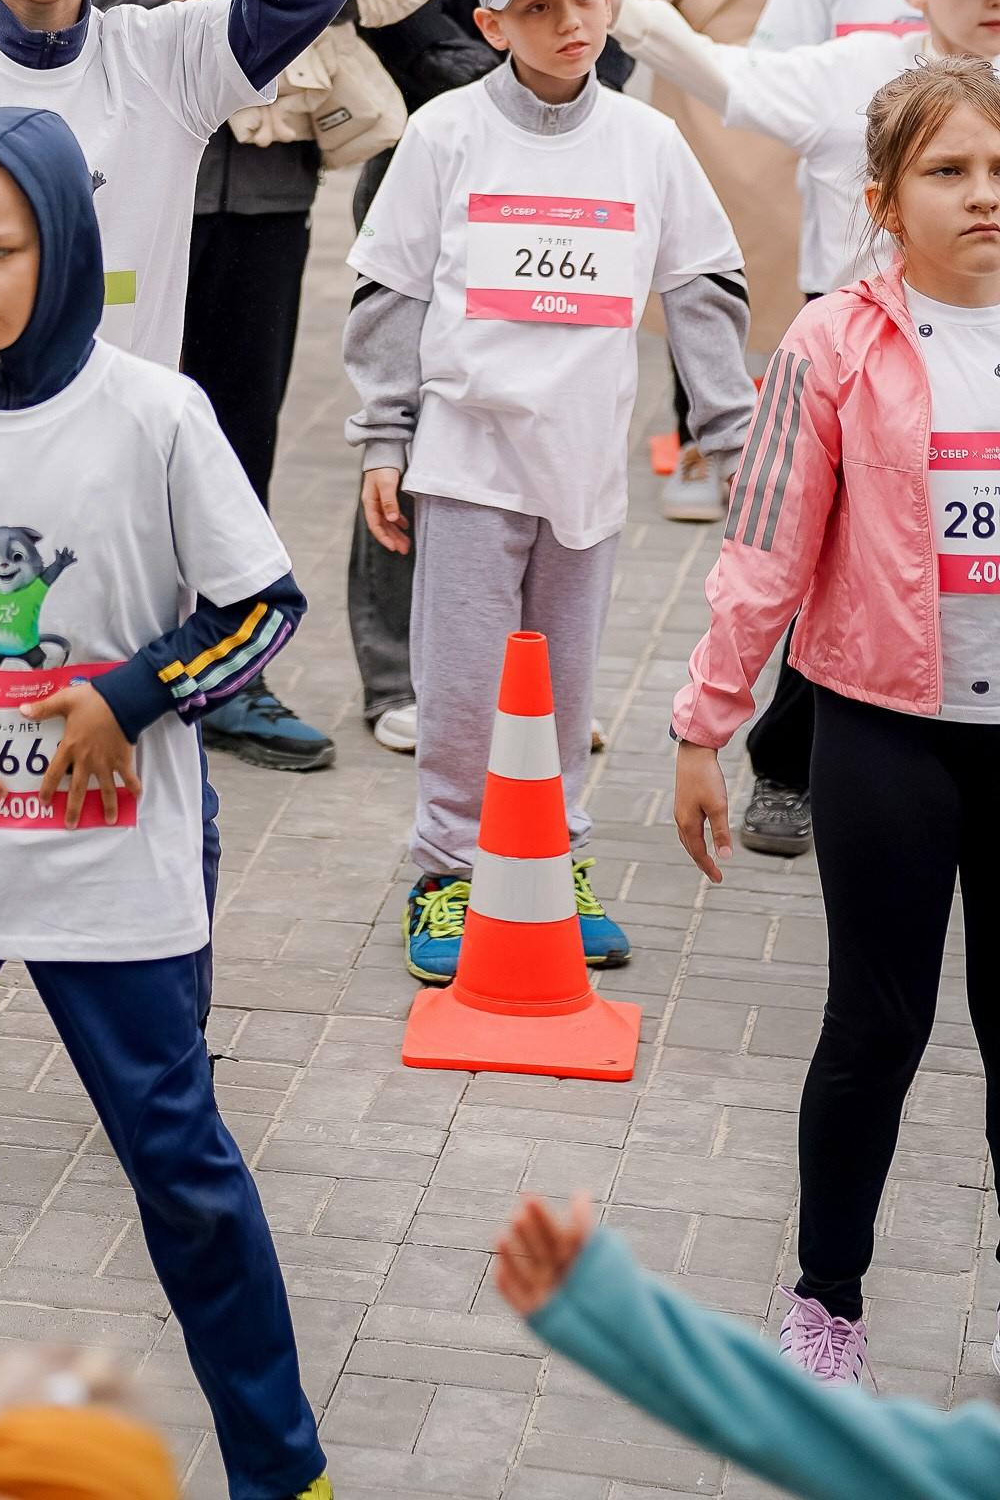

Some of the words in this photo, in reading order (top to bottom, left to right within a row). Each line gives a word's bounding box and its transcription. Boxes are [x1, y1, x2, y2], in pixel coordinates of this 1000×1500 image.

[512, 208, 537, 216] СБЕР
[538, 237, 553, 245] 7-9
[555, 238, 574, 246] ЛЕТ
[515, 248, 598, 281] 2664
[531, 295, 578, 315] 400м
[940, 449, 969, 459] СБЕР
[973, 486, 990, 496] 7-9
[944, 501, 1000, 539] 28
[967, 561, 1000, 583] 40
[18, 722, 41, 733] ЛЕТ
